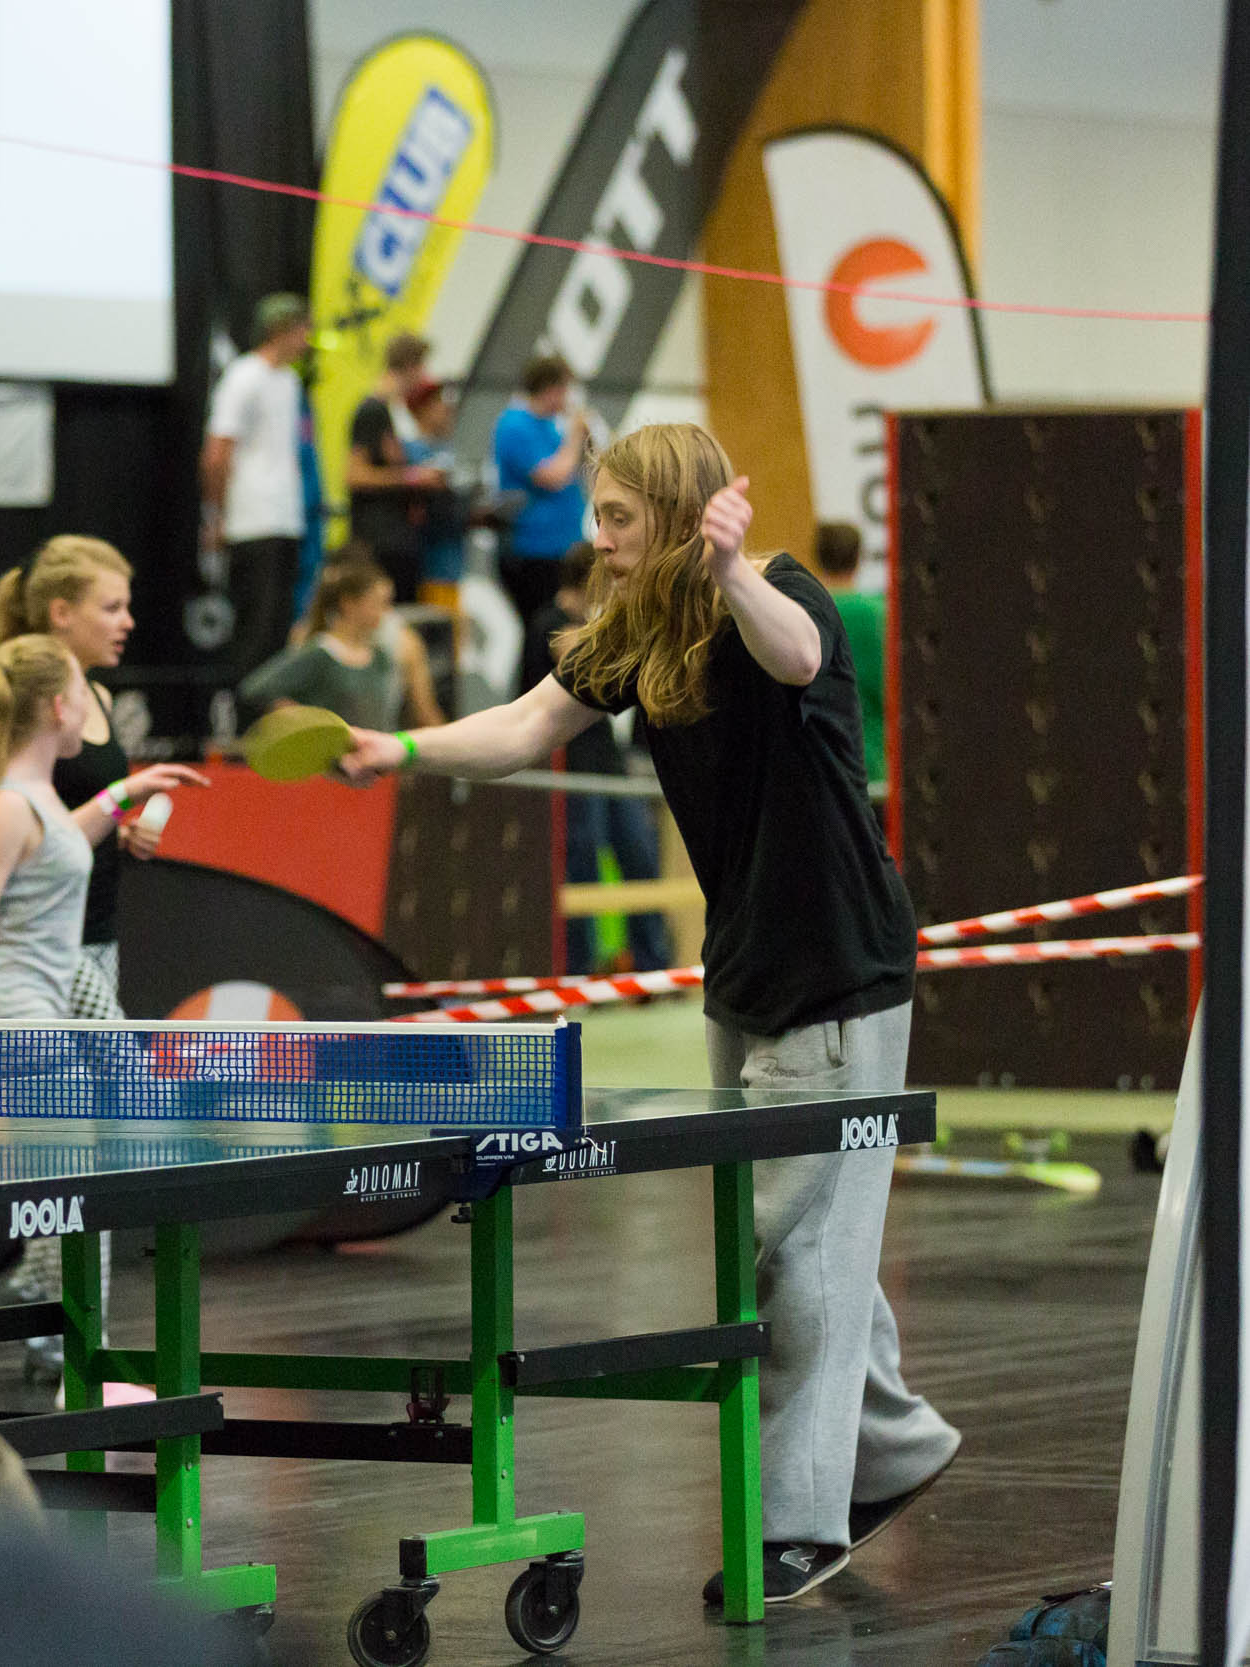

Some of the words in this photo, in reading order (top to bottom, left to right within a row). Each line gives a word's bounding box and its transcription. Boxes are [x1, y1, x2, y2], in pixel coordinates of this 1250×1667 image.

[538, 49, 697, 380] OTT
[476, 1131, 563, 1153] STIGA
[840, 1113, 899, 1151] JOOLA
[360, 1161, 421, 1193] DUOMAT
[9, 1195, 85, 1239] JOOLA
